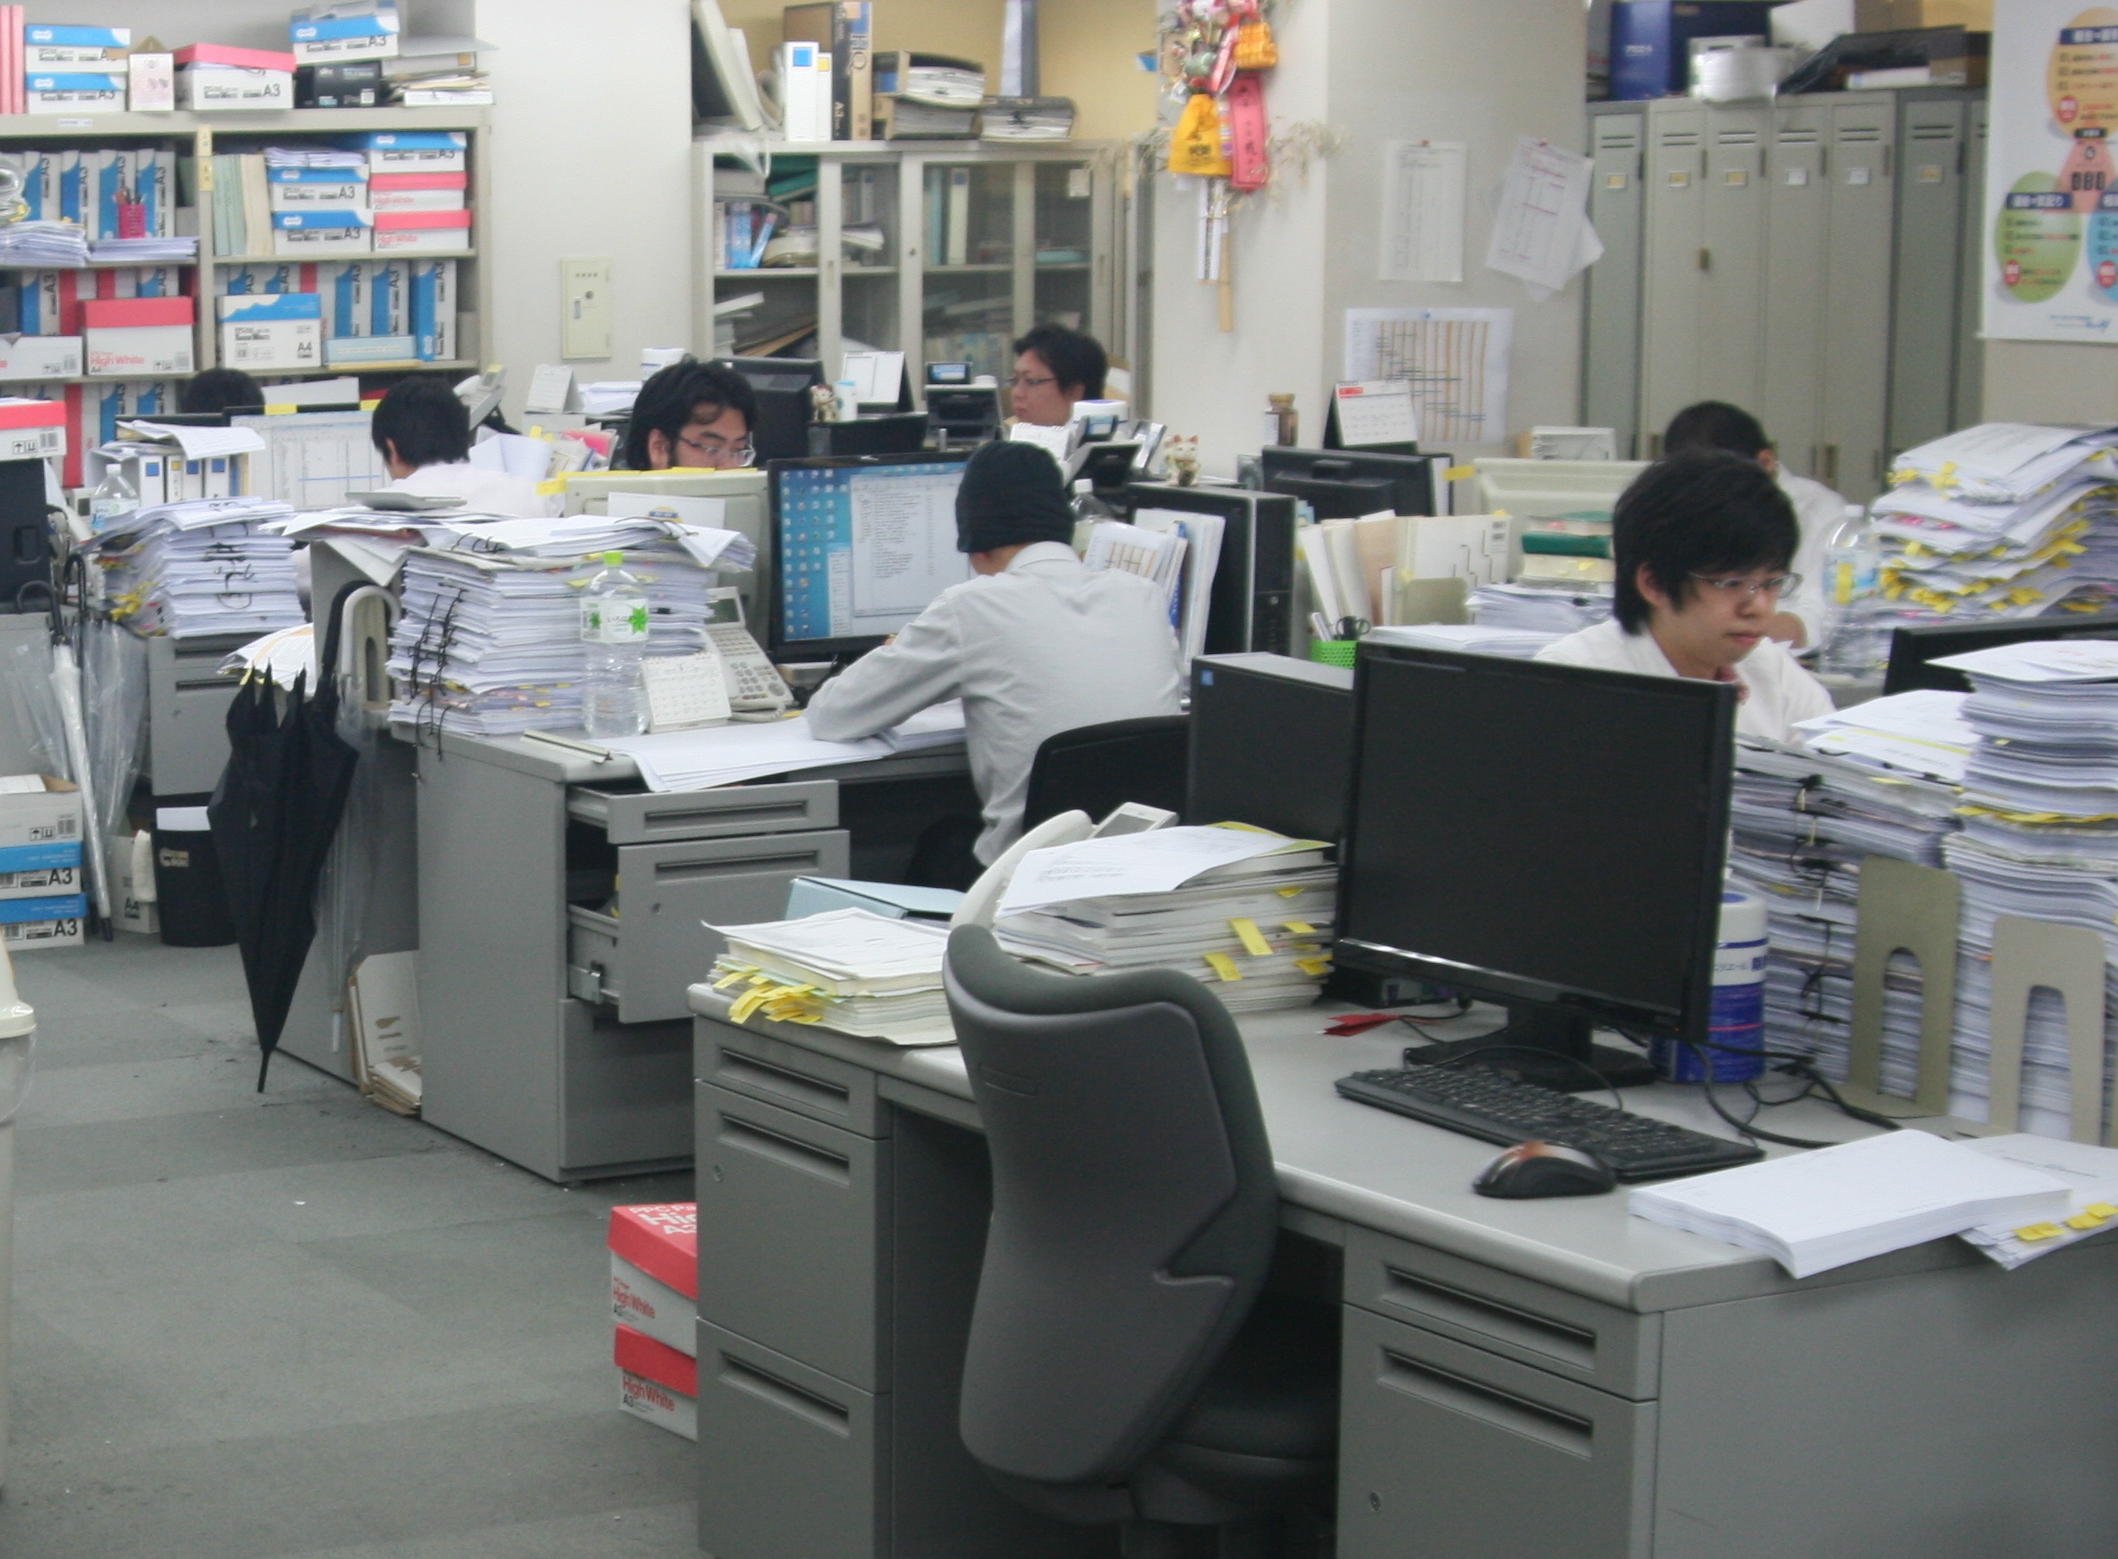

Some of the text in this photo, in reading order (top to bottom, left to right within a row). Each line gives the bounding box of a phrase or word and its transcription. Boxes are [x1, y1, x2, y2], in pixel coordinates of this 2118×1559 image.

[848, 33, 867, 75] HQ
[263, 83, 281, 97] A3
[338, 185, 355, 199] A3
[343, 227, 360, 239] A3
[48, 867, 72, 885] A3
[54, 919, 77, 937] A3
[623, 1375, 674, 1412] High White
